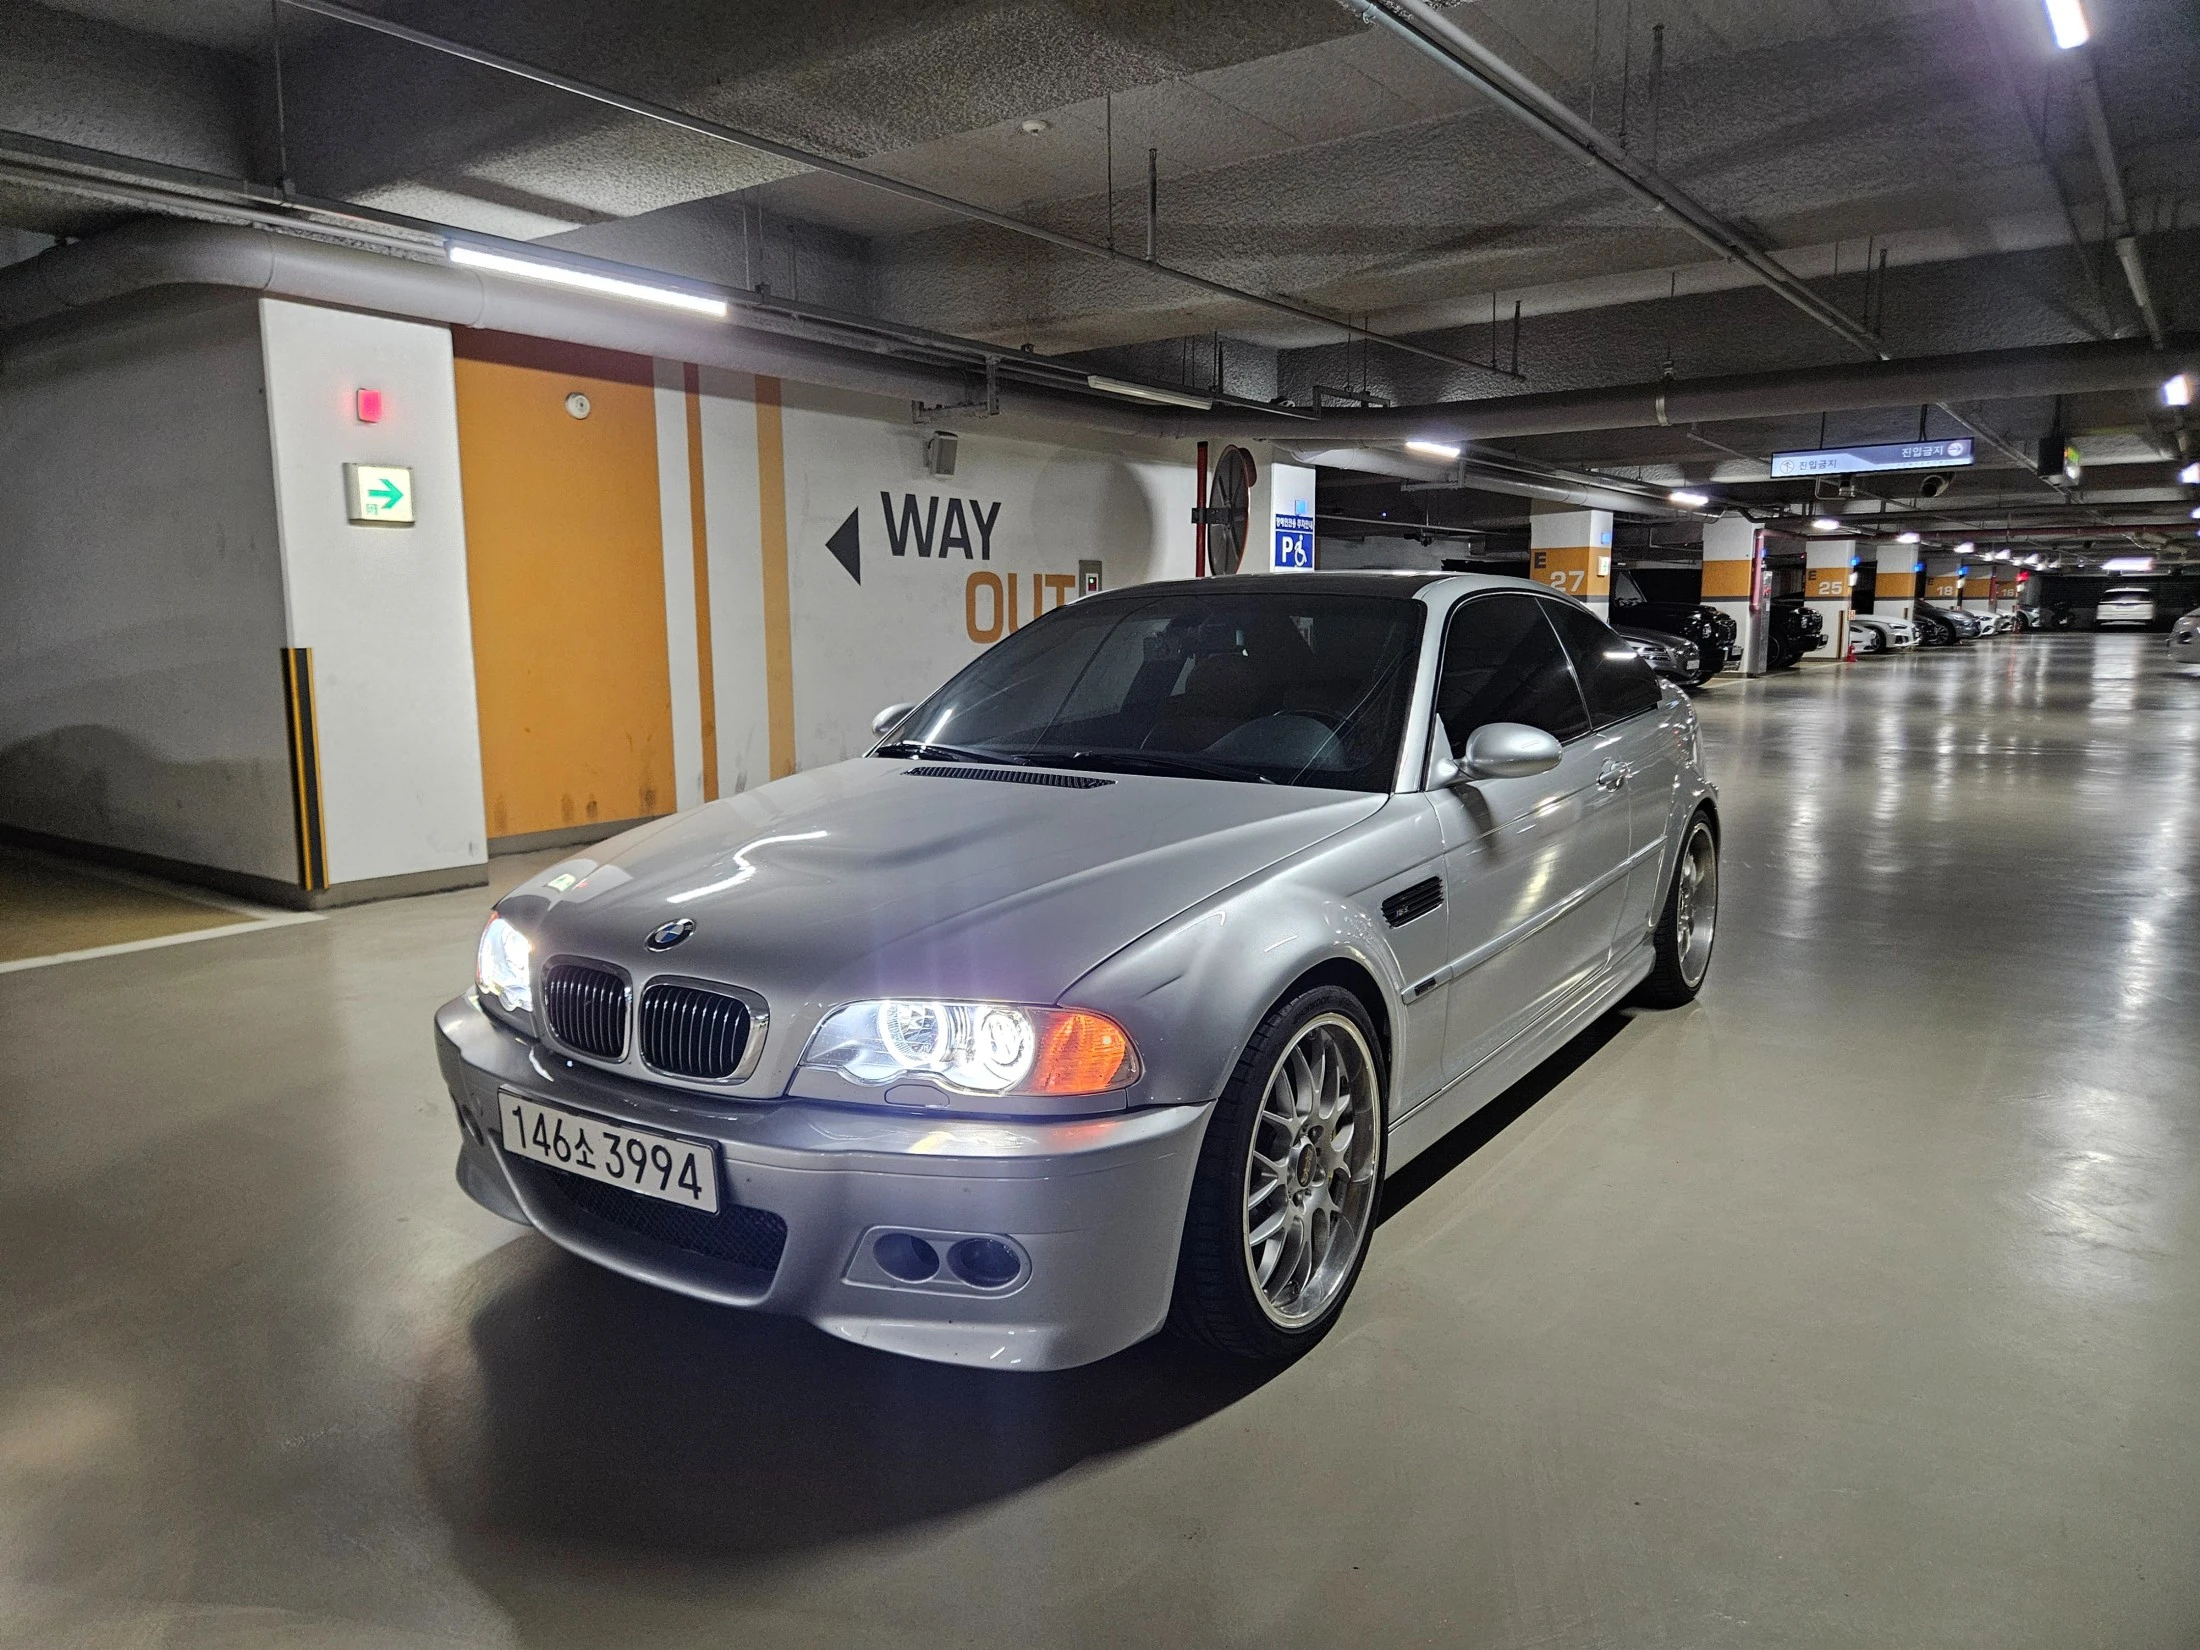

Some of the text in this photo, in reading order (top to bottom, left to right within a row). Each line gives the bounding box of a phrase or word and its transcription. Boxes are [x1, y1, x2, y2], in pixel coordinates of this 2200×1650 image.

[1901, 445, 1943, 458] 진입금지
[1799, 459, 1837, 471] 진입금지
[880, 491, 1001, 560] WAY
[1282, 536, 1293, 563] P
[1534, 552, 1546, 569] E
[1550, 570, 1585, 593] 27
[1808, 570, 1816, 580] E
[1819, 581, 1843, 595] 25
[1936, 586, 1953, 596] 18
[2001, 588, 2015, 597] 16
